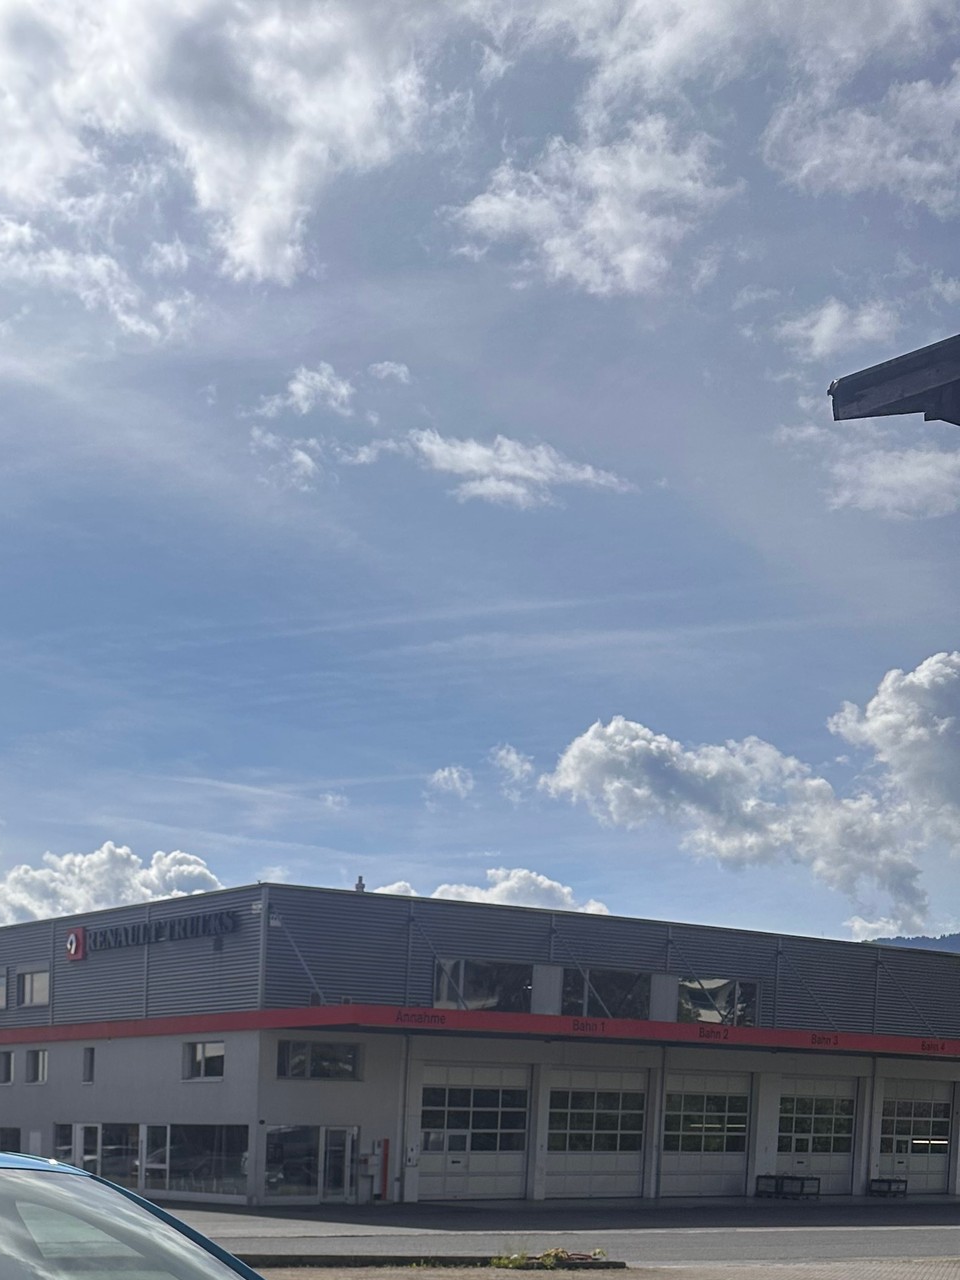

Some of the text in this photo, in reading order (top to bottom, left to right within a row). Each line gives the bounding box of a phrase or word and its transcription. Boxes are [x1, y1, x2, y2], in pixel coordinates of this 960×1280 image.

[396, 1010, 446, 1025] Annahme
[573, 1019, 598, 1032] Bahn
[699, 1027, 722, 1039] Bahn
[811, 1034, 832, 1045] Bahn
